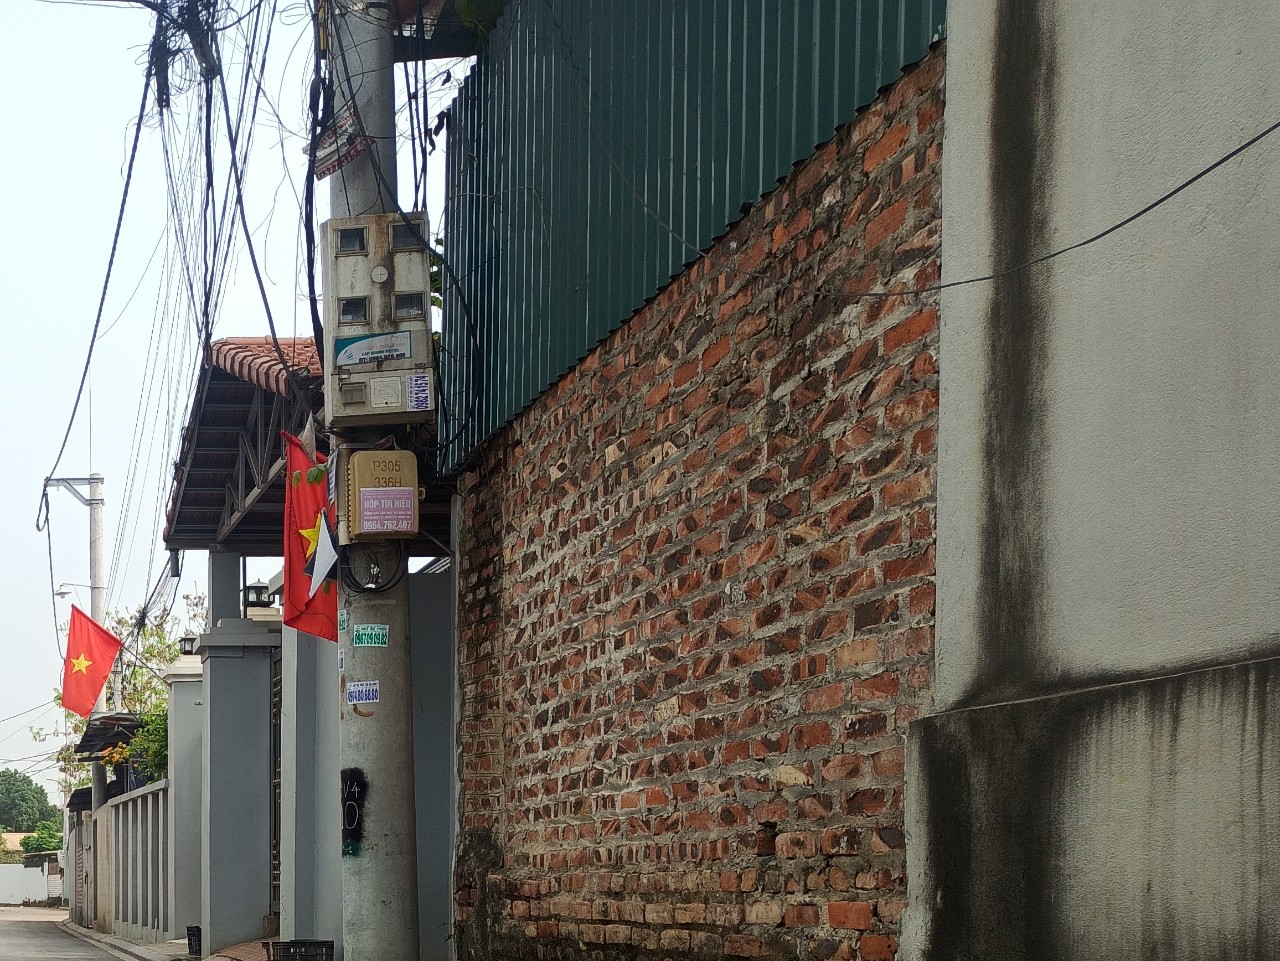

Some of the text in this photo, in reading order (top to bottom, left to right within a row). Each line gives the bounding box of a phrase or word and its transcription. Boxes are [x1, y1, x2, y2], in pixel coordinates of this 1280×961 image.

[373, 460, 401, 472] P305
[374, 476, 402, 488] 336H
[364, 497, 411, 511] HỘP TÍN HIỆU
